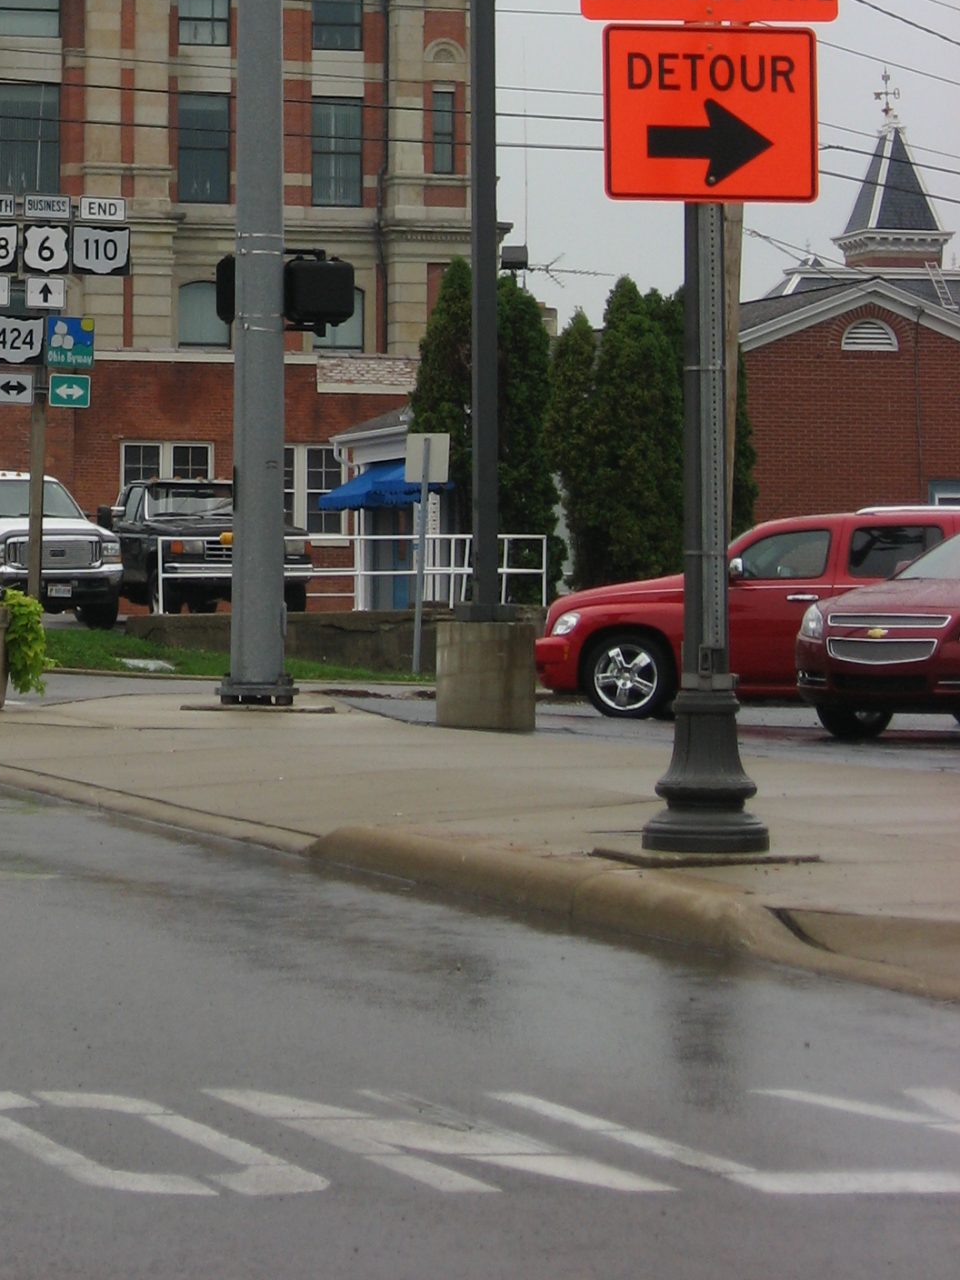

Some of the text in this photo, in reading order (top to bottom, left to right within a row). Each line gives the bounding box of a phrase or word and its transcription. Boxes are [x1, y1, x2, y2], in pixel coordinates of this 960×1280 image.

[626, 51, 796, 94] DETOUR
[27, 198, 67, 213] BUSINESS
[88, 201, 118, 217] END
[37, 235, 55, 262] 6
[83, 238, 118, 261] 110
[47, 350, 66, 362] Ohio
